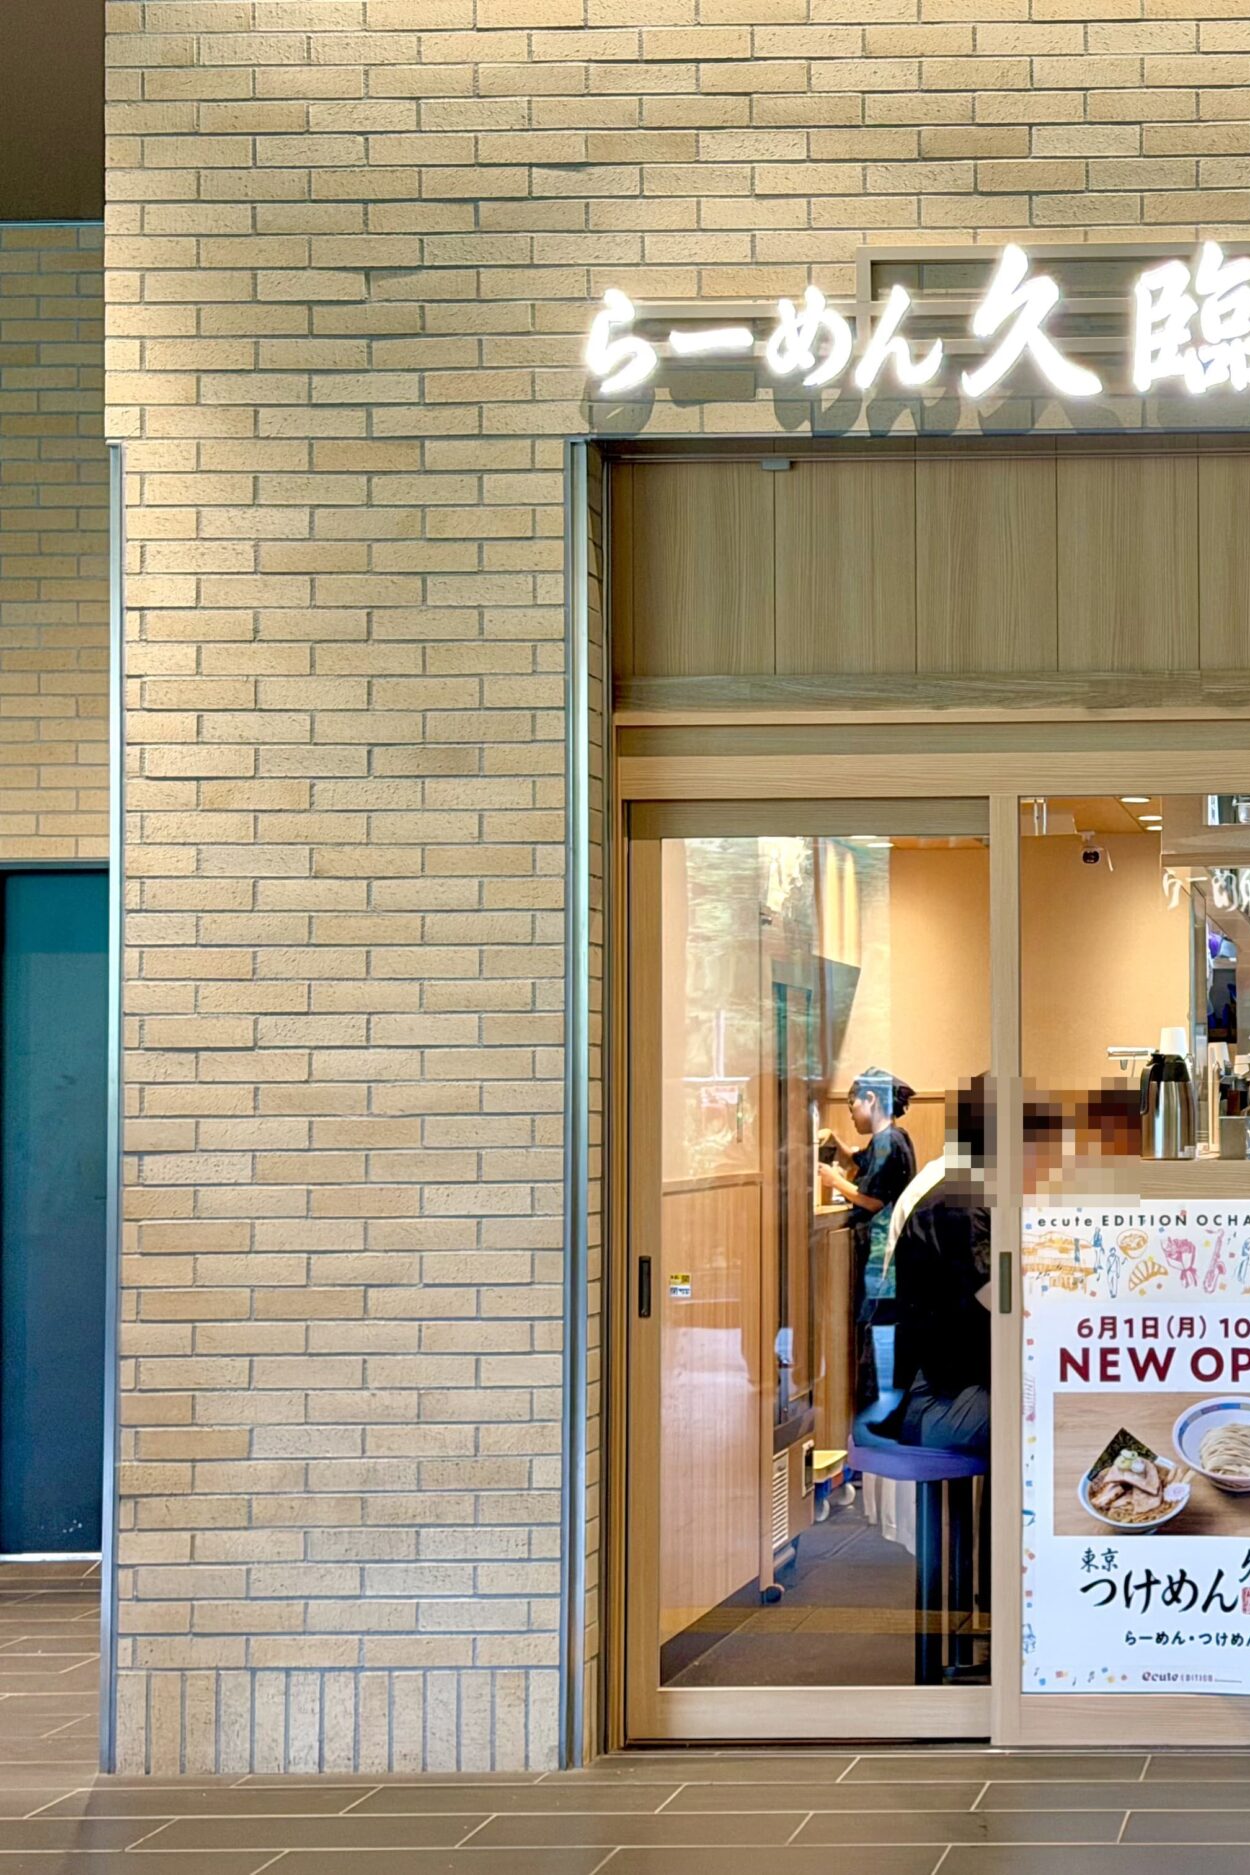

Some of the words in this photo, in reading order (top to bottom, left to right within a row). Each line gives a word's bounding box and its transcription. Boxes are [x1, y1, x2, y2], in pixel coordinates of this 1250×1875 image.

[1037, 1214, 1093, 1228] ecute
[1102, 1214, 1188, 1227] EDITION
[1076, 1315, 1208, 1340] 6月1日(月)
[1059, 1346, 1177, 1384] NEW
[1080, 1547, 1119, 1573] 東京
[1079, 1568, 1239, 1614] つけめん
[1142, 1671, 1178, 1682] ecute
